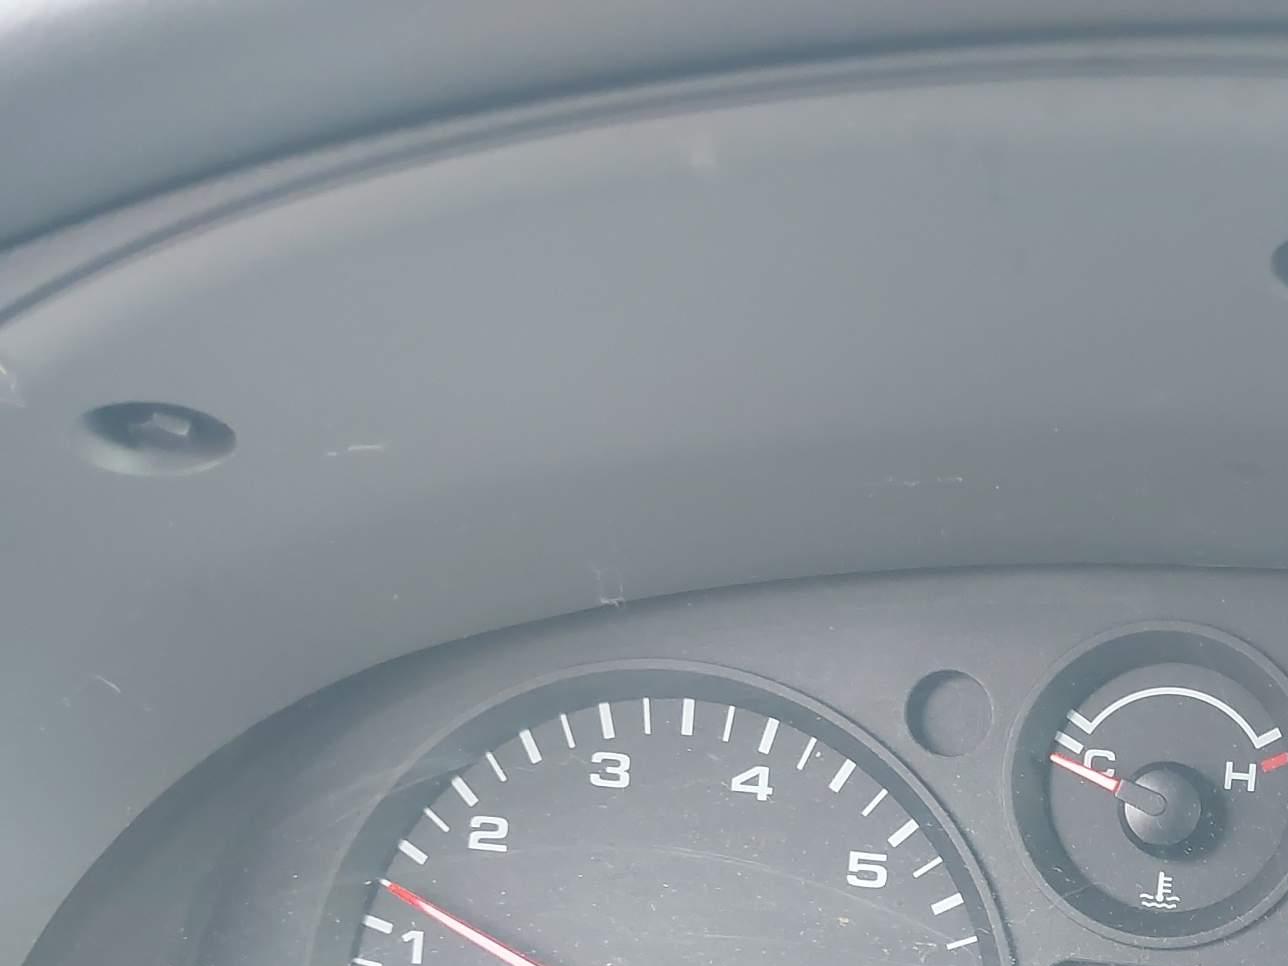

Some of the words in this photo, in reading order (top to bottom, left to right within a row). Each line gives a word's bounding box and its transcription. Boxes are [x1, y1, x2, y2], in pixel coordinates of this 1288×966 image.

[590, 753, 630, 788] 3
[1083, 749, 1116, 779] C
[1224, 762, 1256, 791] H
[731, 767, 774, 800] 4
[468, 816, 509, 852] 2
[846, 851, 888, 889] 5
[402, 931, 423, 964] 1
